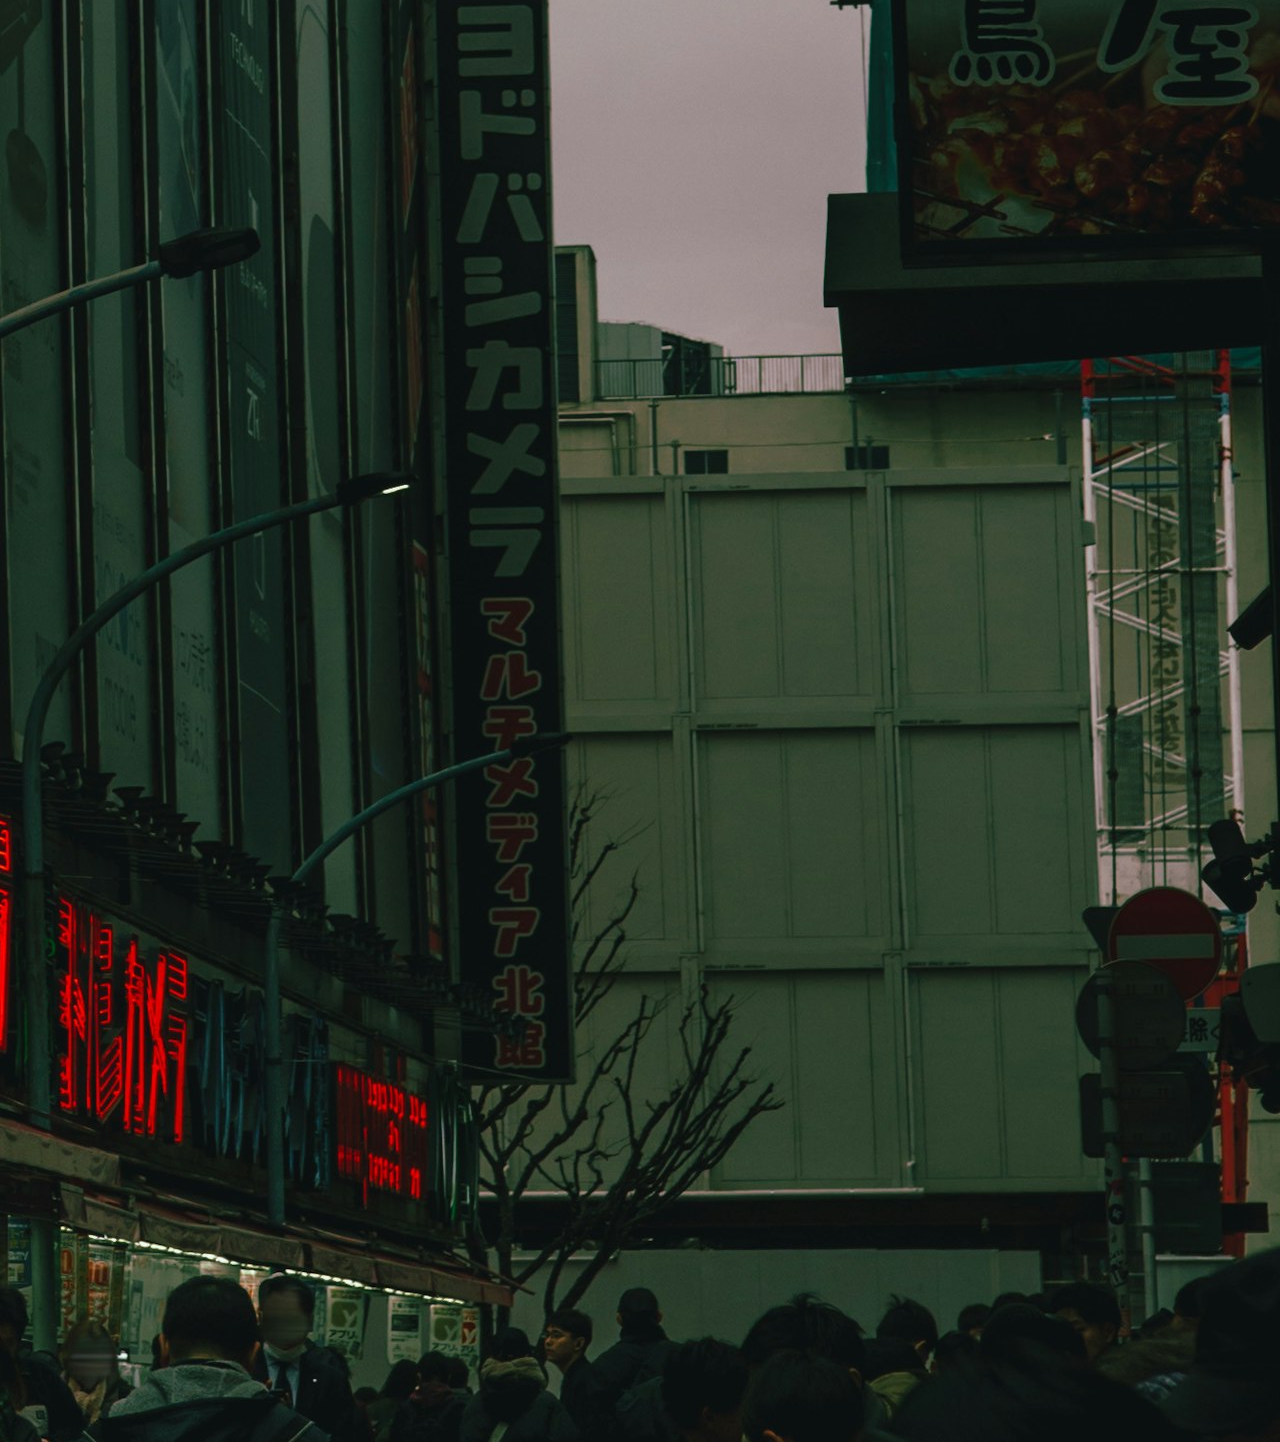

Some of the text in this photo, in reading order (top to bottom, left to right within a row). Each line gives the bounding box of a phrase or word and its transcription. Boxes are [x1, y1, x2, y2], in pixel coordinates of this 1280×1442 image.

[456, 4, 547, 581] ヨドバシカメラ
[479, 594, 546, 1070] マルチメディア 北館
